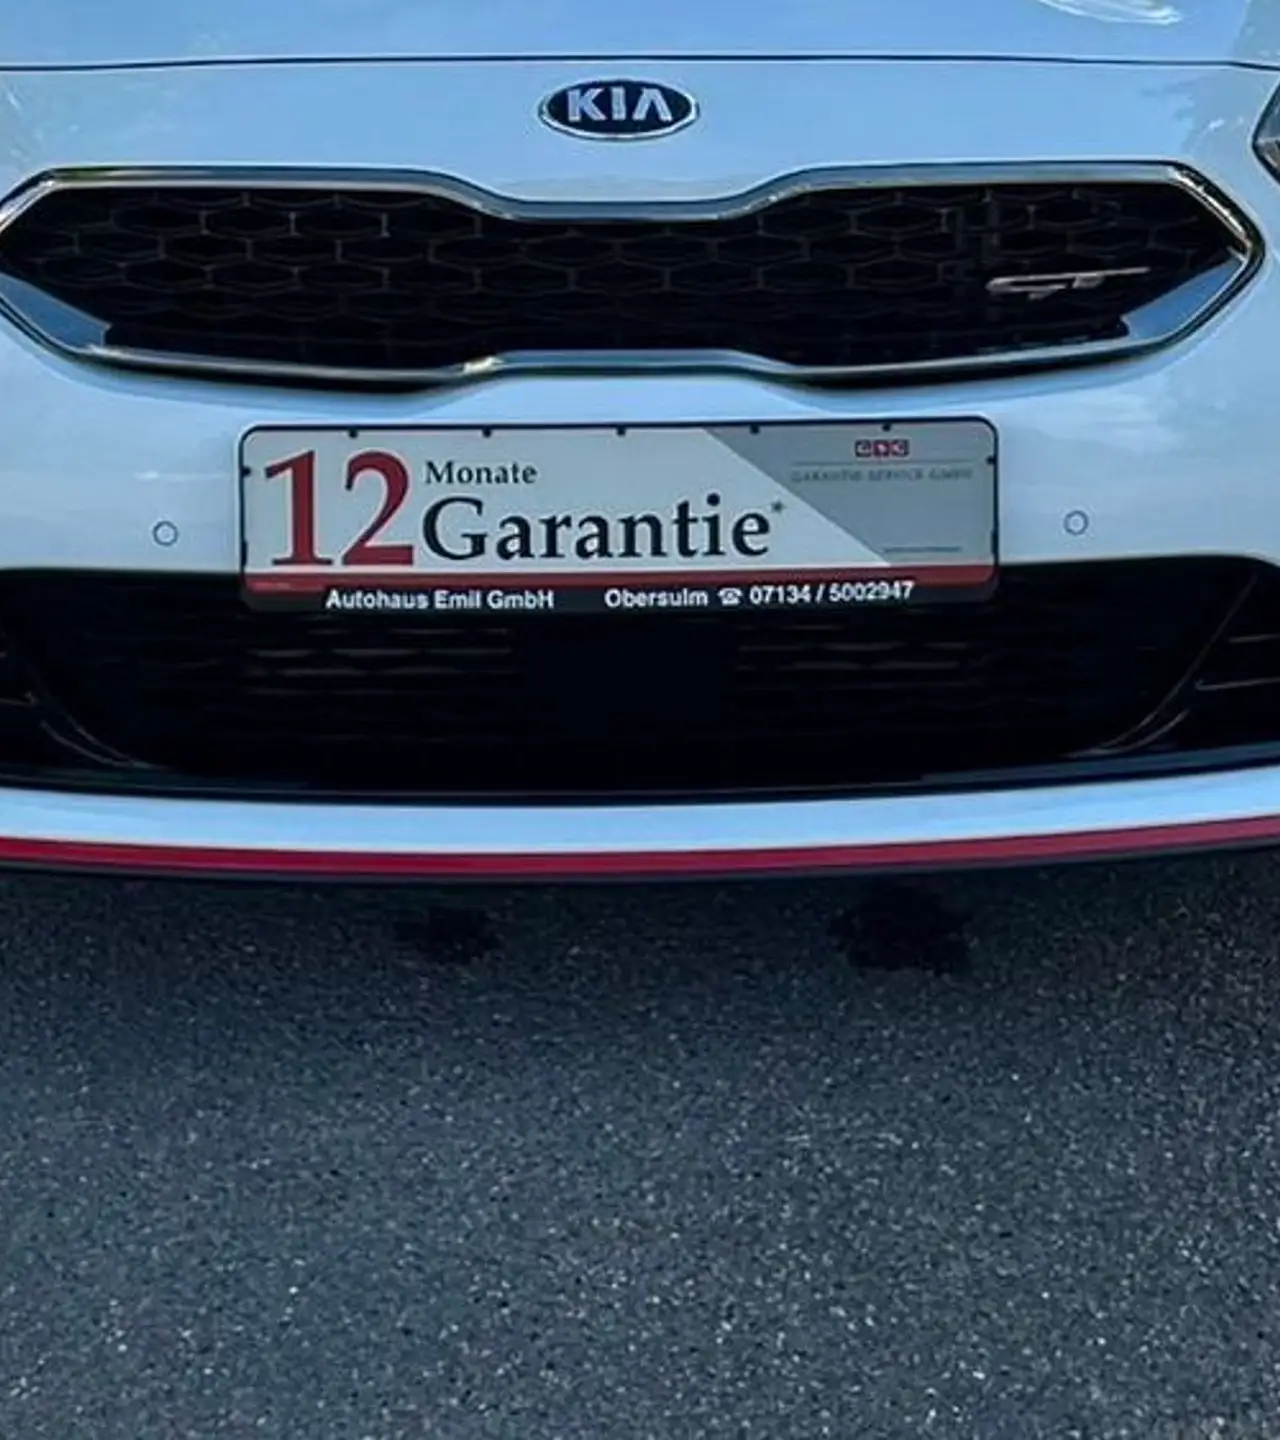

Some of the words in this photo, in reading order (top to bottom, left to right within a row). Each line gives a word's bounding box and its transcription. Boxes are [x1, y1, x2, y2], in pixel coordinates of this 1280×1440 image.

[567, 86, 673, 122] KIA
[425, 460, 537, 485] Monate
[265, 449, 414, 567] 12
[326, 589, 429, 609] Autohaus
[434, 589, 481, 609] Emil
[487, 589, 555, 608] GmbH
[604, 587, 709, 608] Obersulm
[750, 583, 811, 604] 07134
